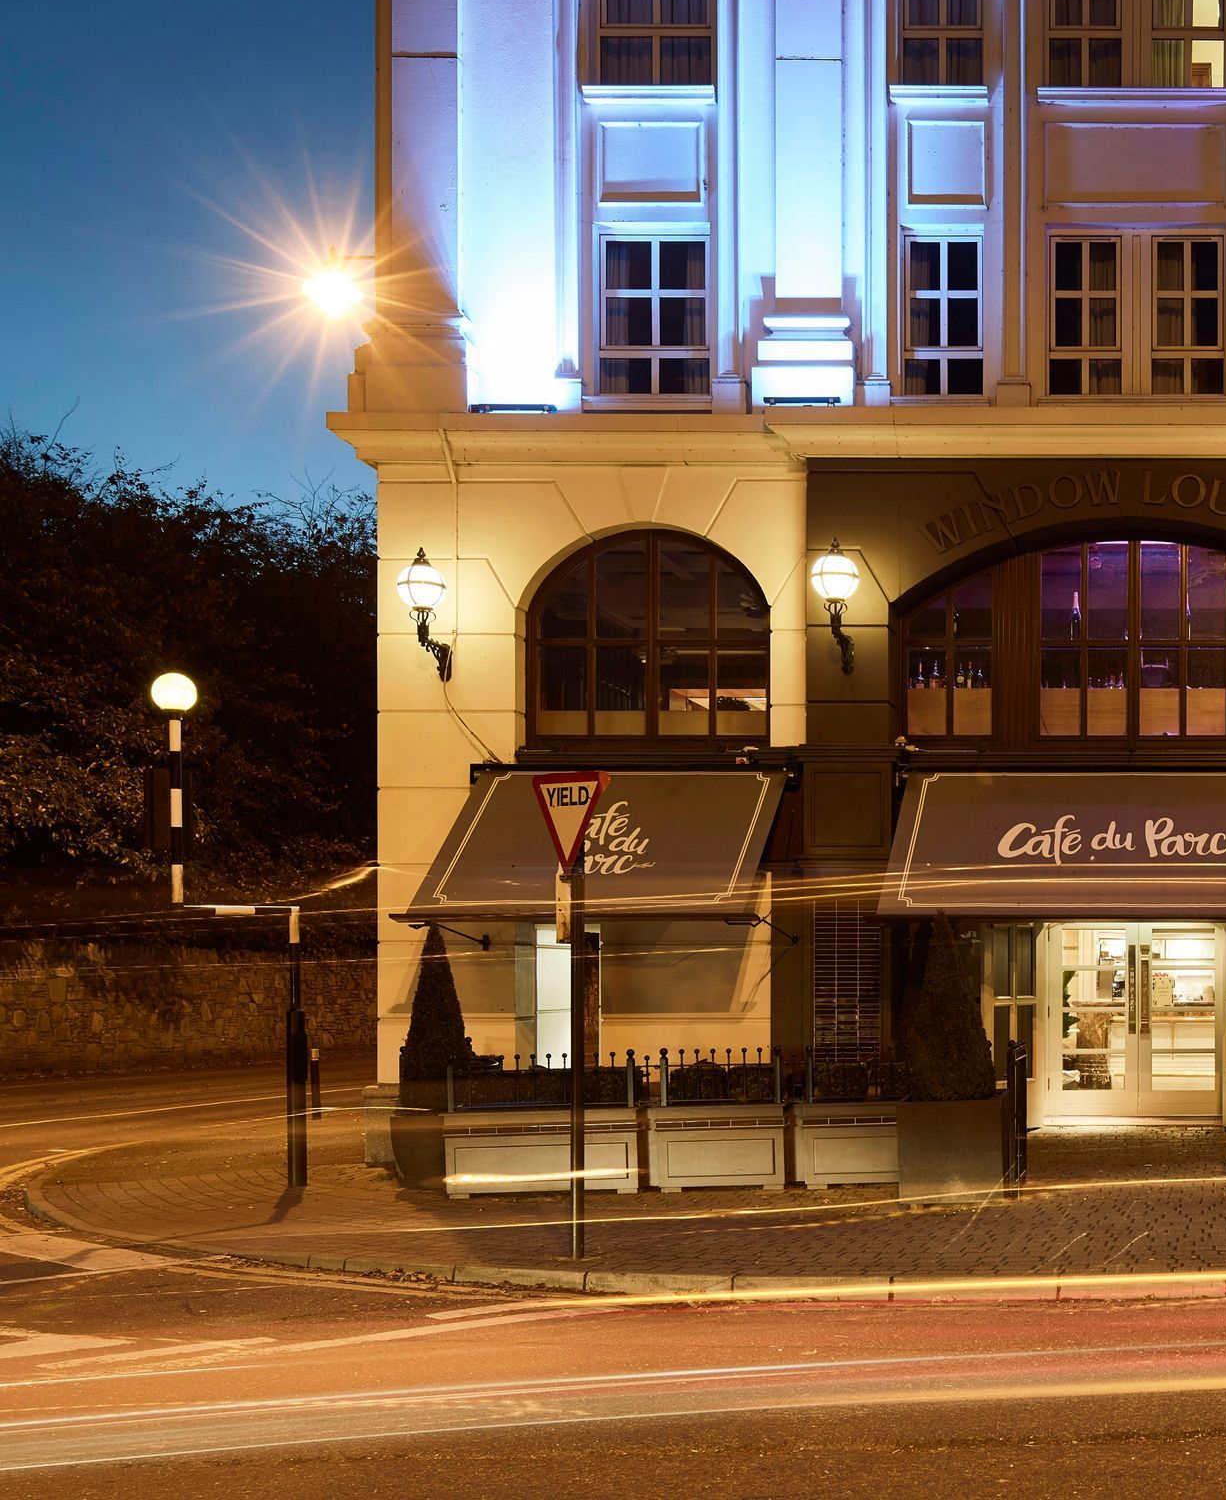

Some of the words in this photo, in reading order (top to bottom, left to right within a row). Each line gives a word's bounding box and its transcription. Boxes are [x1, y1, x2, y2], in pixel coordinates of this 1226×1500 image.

[919, 470, 1123, 554] WINDOW
[547, 786, 589, 807] YIELD
[585, 801, 630, 845] afé
[609, 827, 649, 854] du
[997, 814, 1082, 867] Café
[1091, 821, 1136, 851] du
